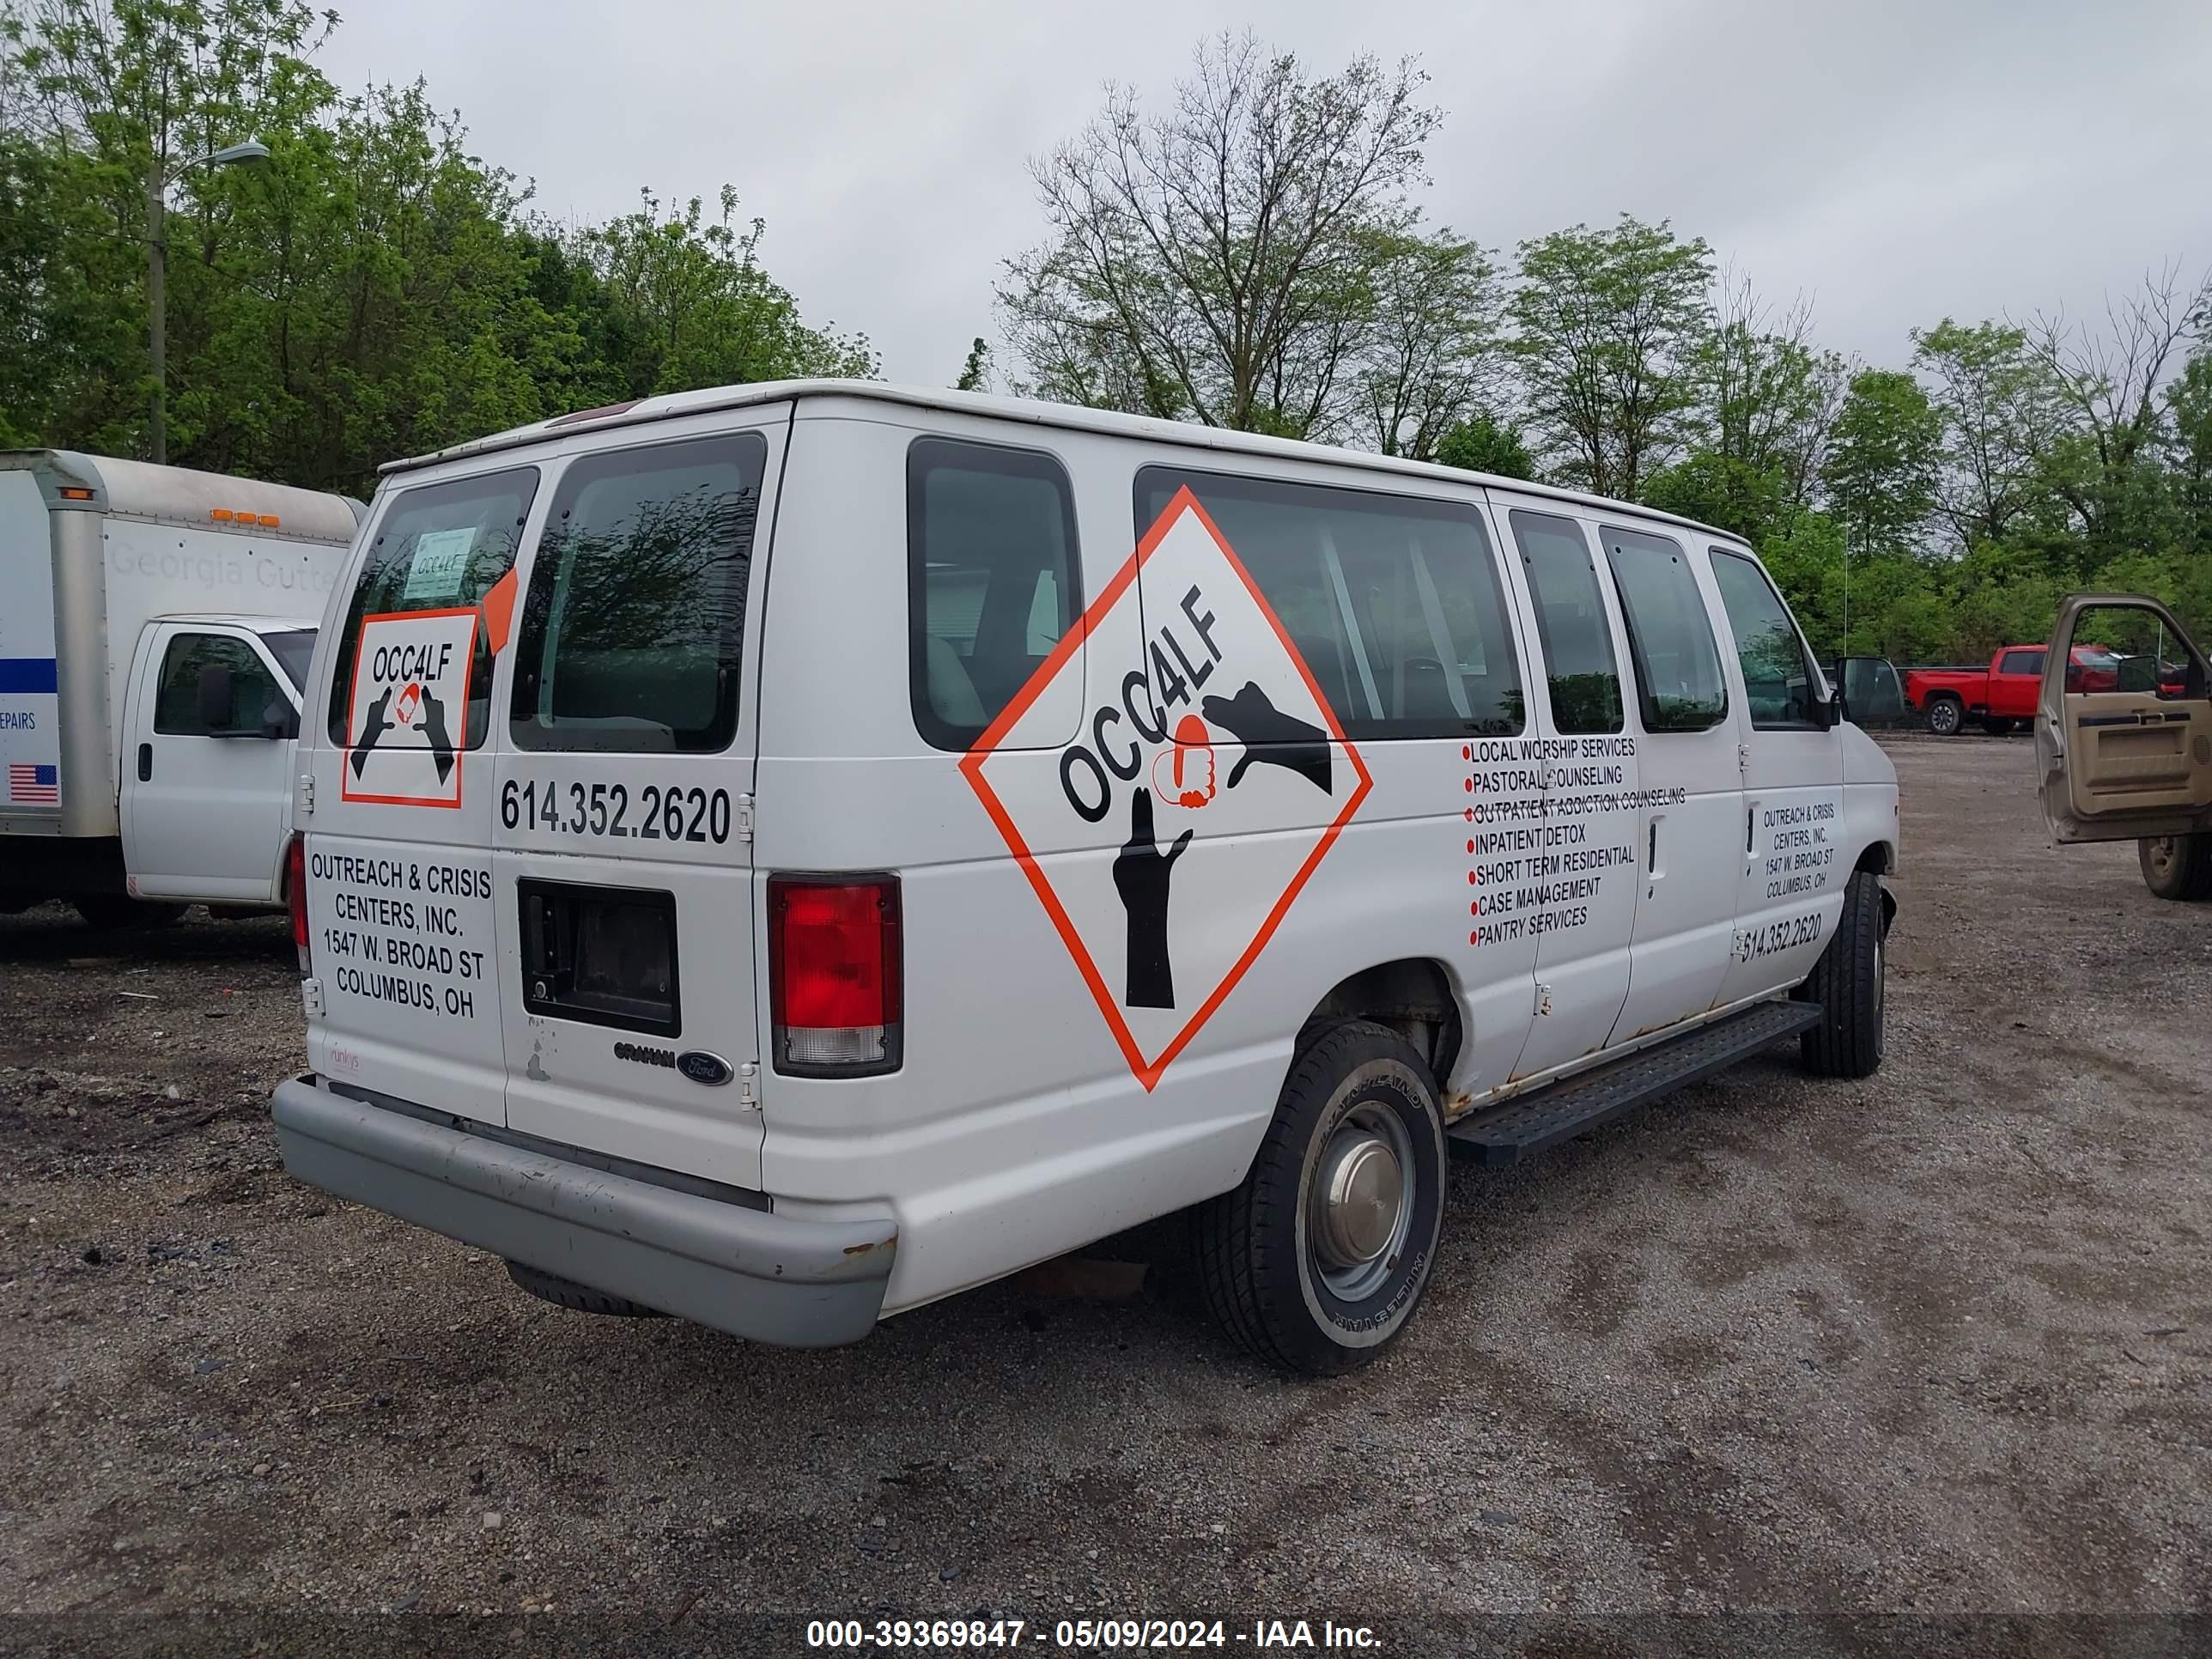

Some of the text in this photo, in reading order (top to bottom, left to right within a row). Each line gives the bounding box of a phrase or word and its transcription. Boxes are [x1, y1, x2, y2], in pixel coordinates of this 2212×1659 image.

[373, 643, 453, 683] OCC4LF
[0, 712, 35, 730] EPAIRS
[1060, 584, 1223, 823] OCC4LF
[1471, 738, 1635, 763] LOCAL WORSHIP SERVICES
[1473, 769, 1545, 793] PASTORAL
[501, 780, 730, 845] 614.352.2620
[1474, 787, 1686, 823] OUTPATIENT ADDICTION COUNSELING
[1764, 803, 1834, 828] OUTREACH & CRISIS
[1475, 823, 1586, 855] INPATIENT DETOX
[1774, 827, 1827, 850] CENTERS, INC.
[313, 853, 491, 899] OUTREACH & CRISIS
[1477, 845, 1634, 885] SHORT TERM RESIDENTIAL
[1765, 848, 1834, 876] 1547 W. BROAD ST
[1479, 877, 1601, 916] CASE MANAGEMENT
[1767, 872, 1826, 899] COLUMBUS, OH
[335, 893, 464, 937] CENTERS, INC.
[1478, 906, 1588, 947] PANTRY SERVICES
[324, 928, 483, 981] 1547 W. BROAD ST
[1742, 912, 1821, 963] 614.352.2620
[337, 966, 473, 1019] COLUMBUS, OH
[614, 1042, 676, 1069] GRAHAM
